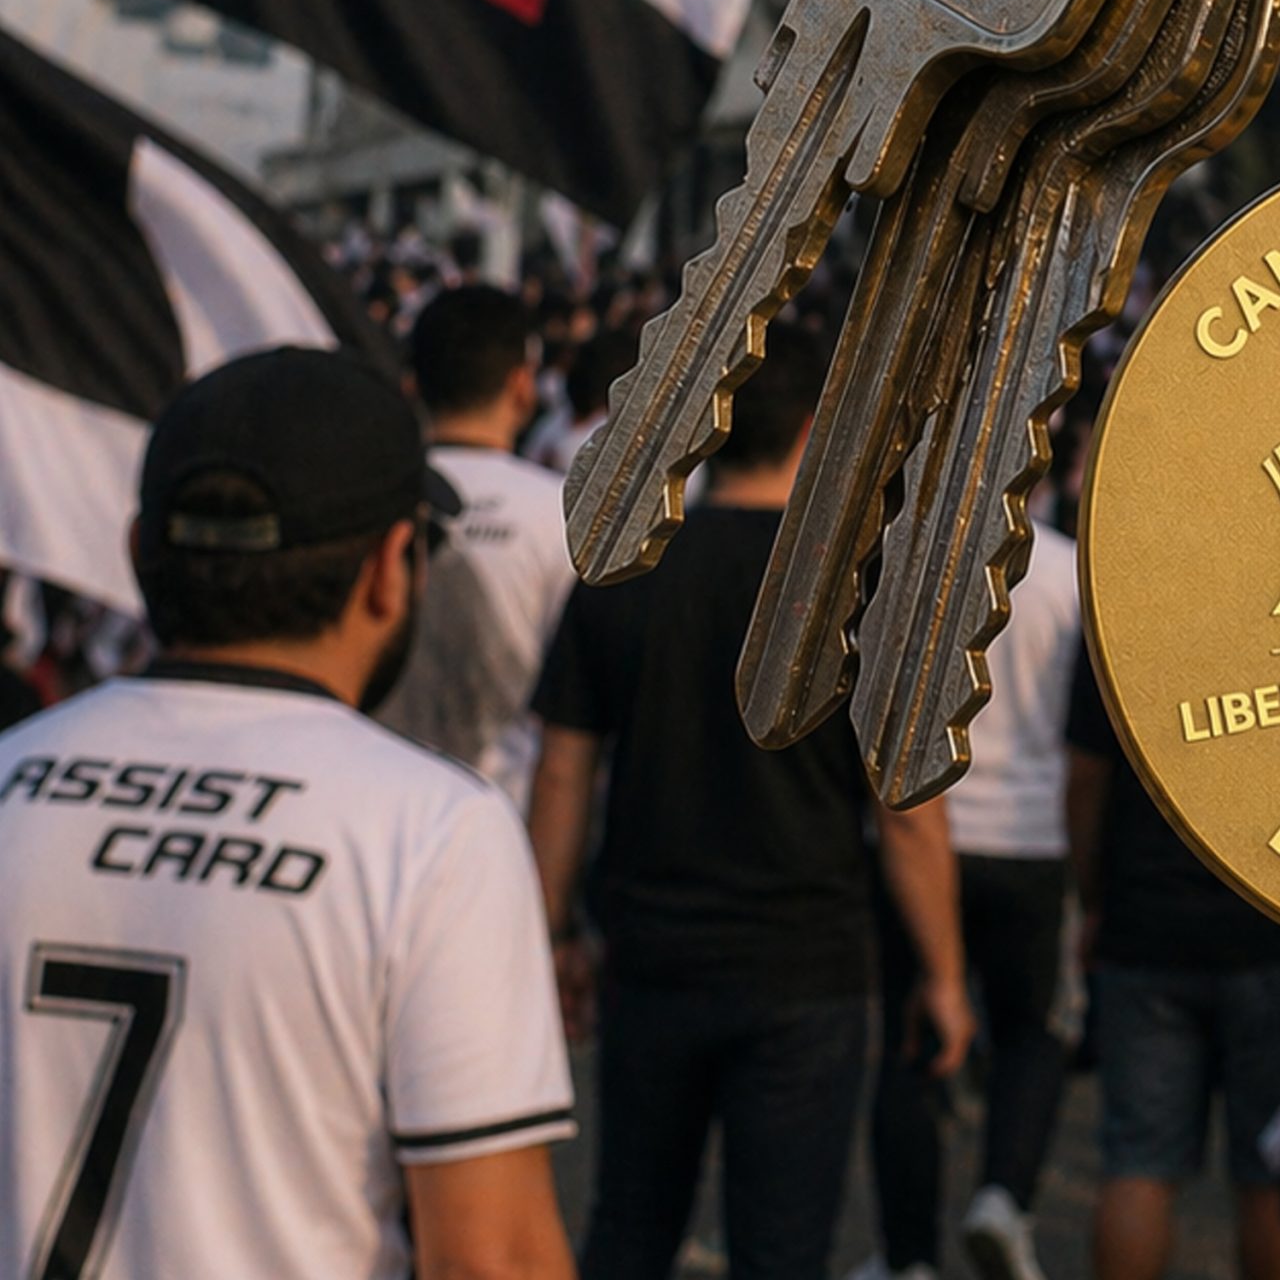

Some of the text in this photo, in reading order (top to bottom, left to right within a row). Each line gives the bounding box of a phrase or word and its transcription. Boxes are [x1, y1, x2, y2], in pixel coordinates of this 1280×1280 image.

[0, 756, 304, 821] ASSIST
[91, 825, 327, 895] CARD
[26, 940, 188, 1280] 7
